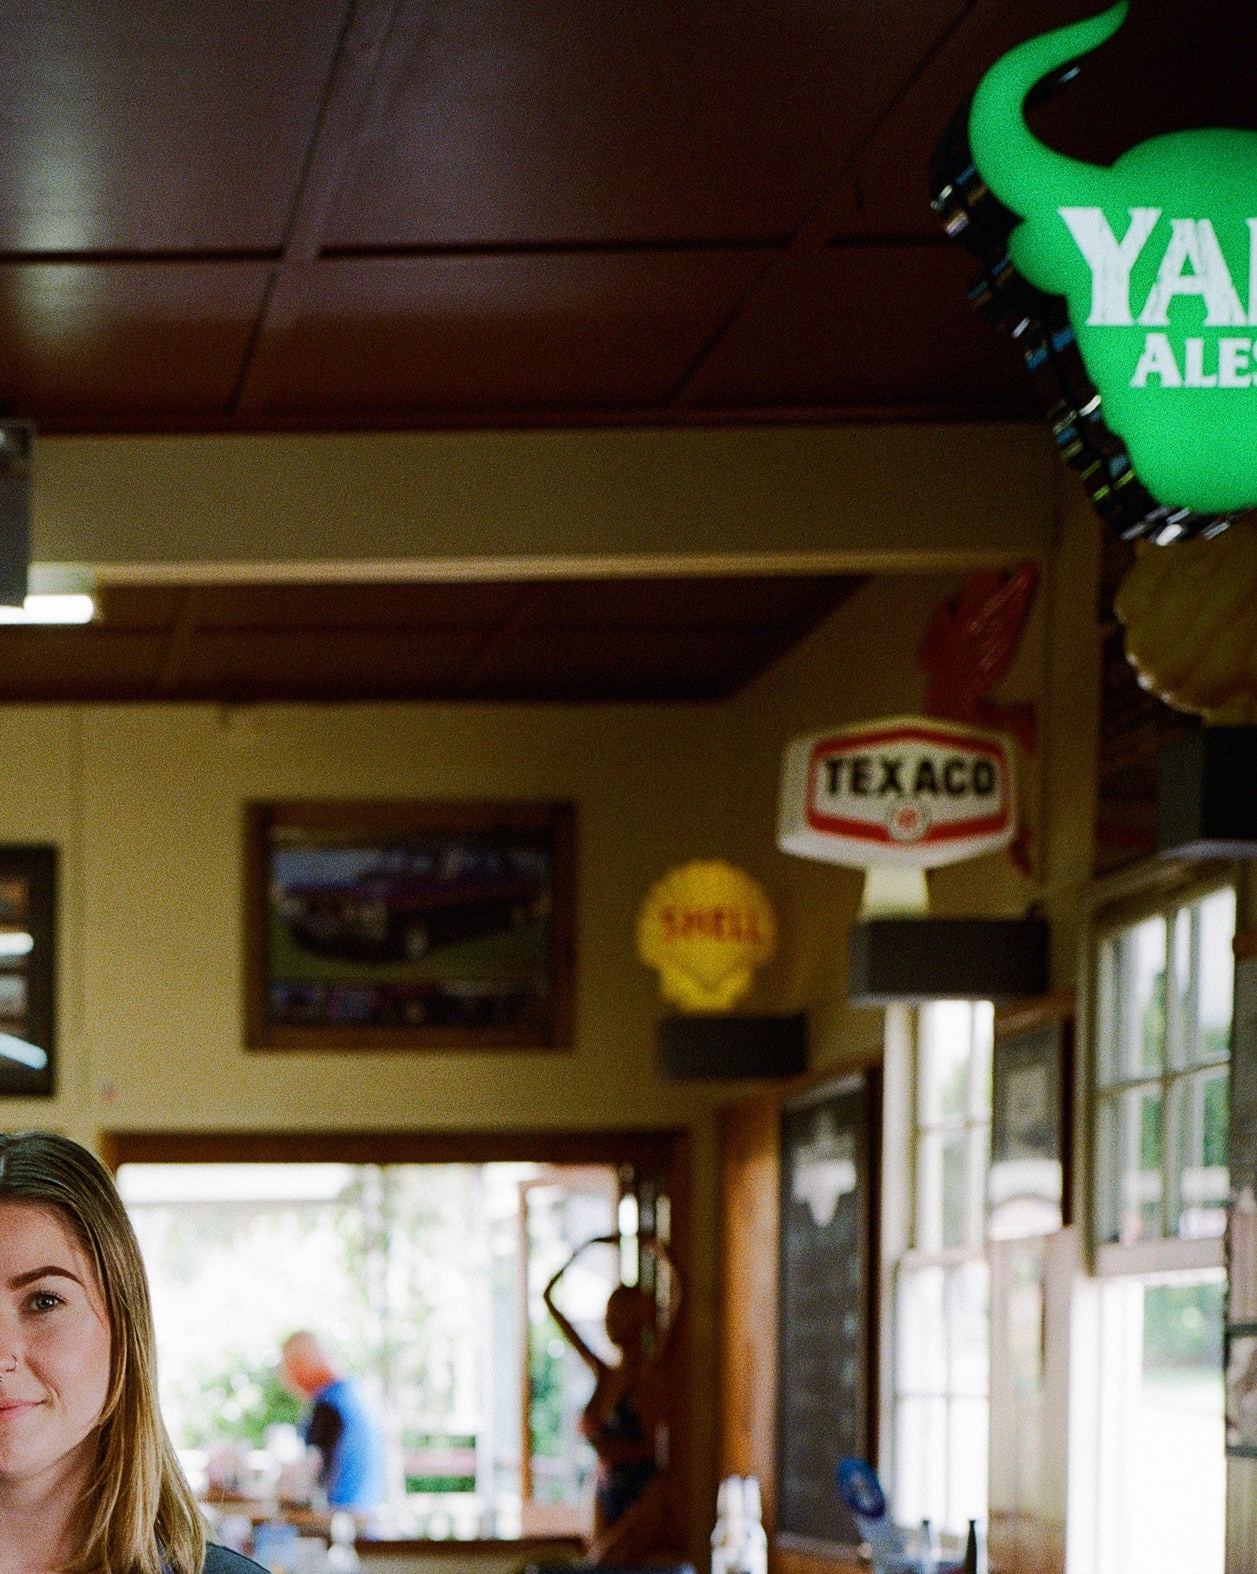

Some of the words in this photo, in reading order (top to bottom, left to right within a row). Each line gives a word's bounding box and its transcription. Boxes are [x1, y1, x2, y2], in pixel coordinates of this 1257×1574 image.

[1059, 206, 1257, 327] YA
[1129, 332, 1257, 388] ALE
[825, 756, 997, 798] TEXACO
